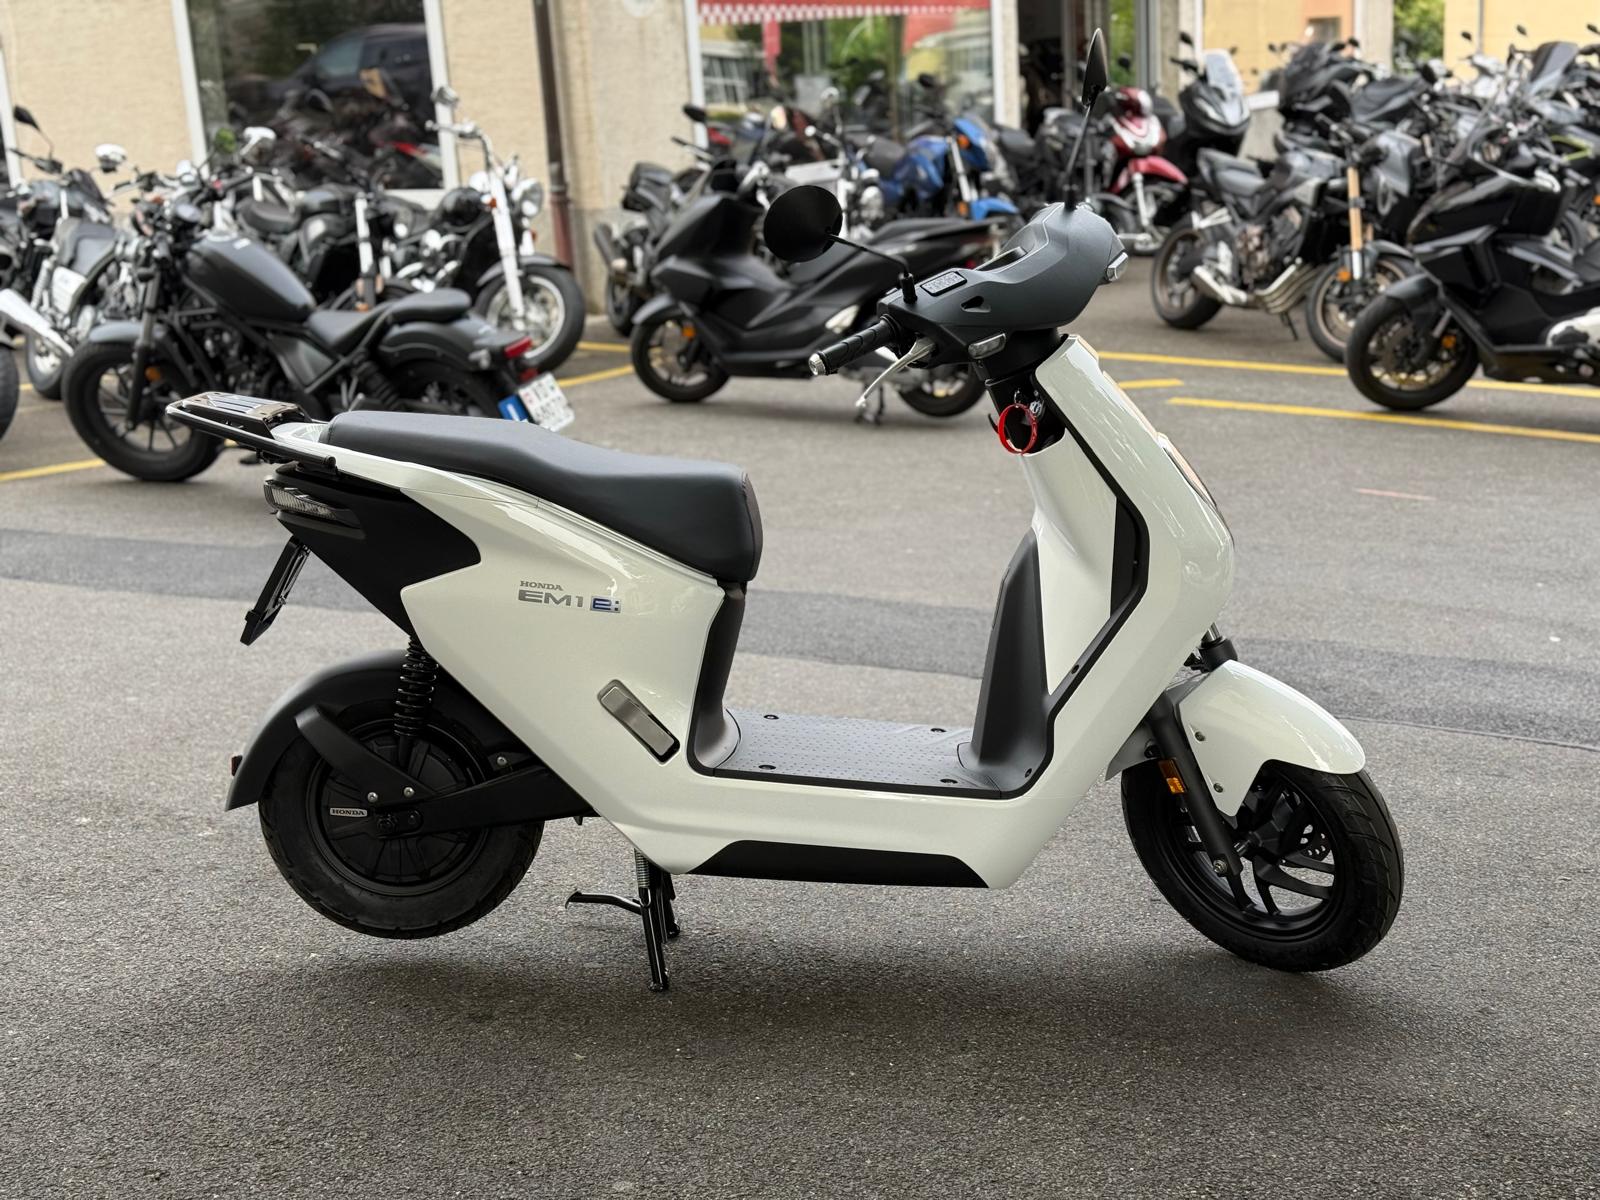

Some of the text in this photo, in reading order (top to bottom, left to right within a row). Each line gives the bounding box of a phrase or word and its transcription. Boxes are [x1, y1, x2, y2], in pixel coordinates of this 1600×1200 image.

[520, 580, 563, 591] HONDA
[518, 590, 584, 608] EM1
[332, 808, 365, 816] HONDA
